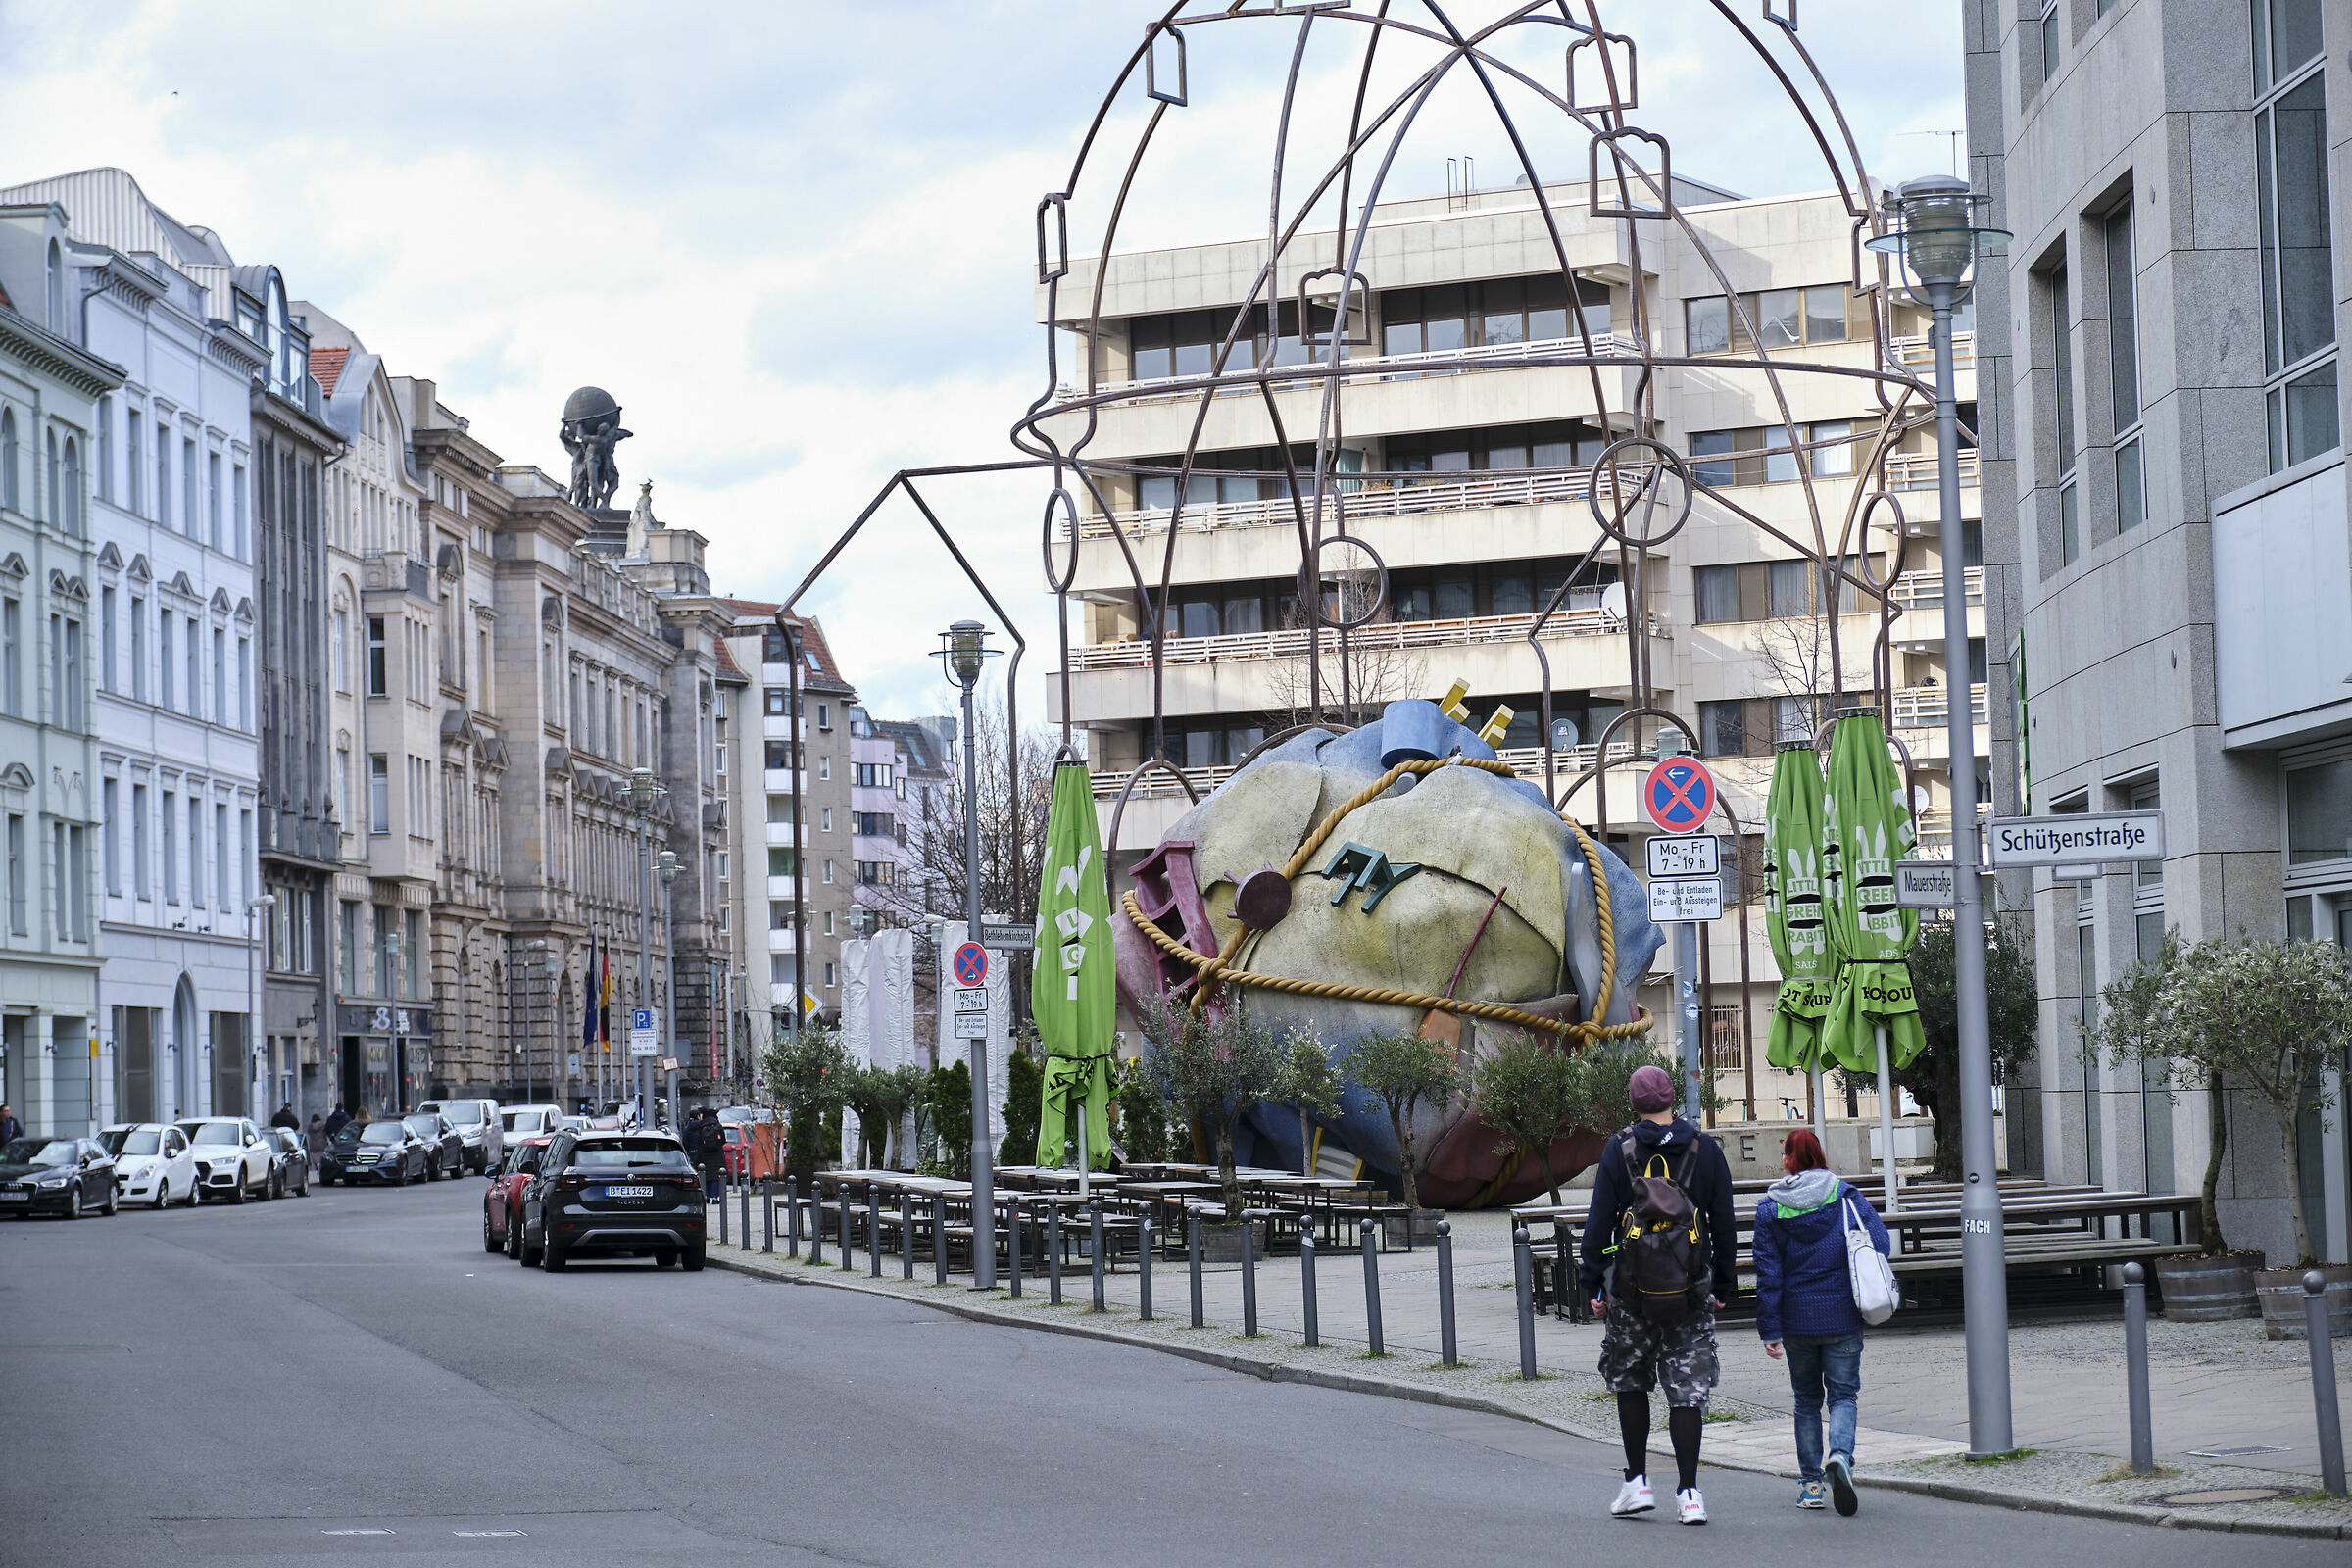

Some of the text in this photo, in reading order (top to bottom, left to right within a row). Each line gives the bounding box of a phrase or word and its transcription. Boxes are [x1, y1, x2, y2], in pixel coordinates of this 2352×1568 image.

[2001, 821, 2146, 855] Schützenstraße
[1659, 843, 1679, 856] Mo
[1691, 841, 1705, 854] Fr
[1661, 858, 1669, 871] 7
[1683, 857, 1694, 870] 19
[1699, 857, 1706, 869] h
[1657, 887, 1670, 896] Be-
[1686, 886, 1713, 895] Entladen
[1787, 879, 1817, 894] LITTL
[1904, 870, 1952, 898] Mauerstraße
[1653, 897, 1667, 906] Ein-
[1684, 896, 1718, 906] Aussteigen
[959, 992, 969, 1001] Mo
[1964, 1219, 1991, 1234] FACH
